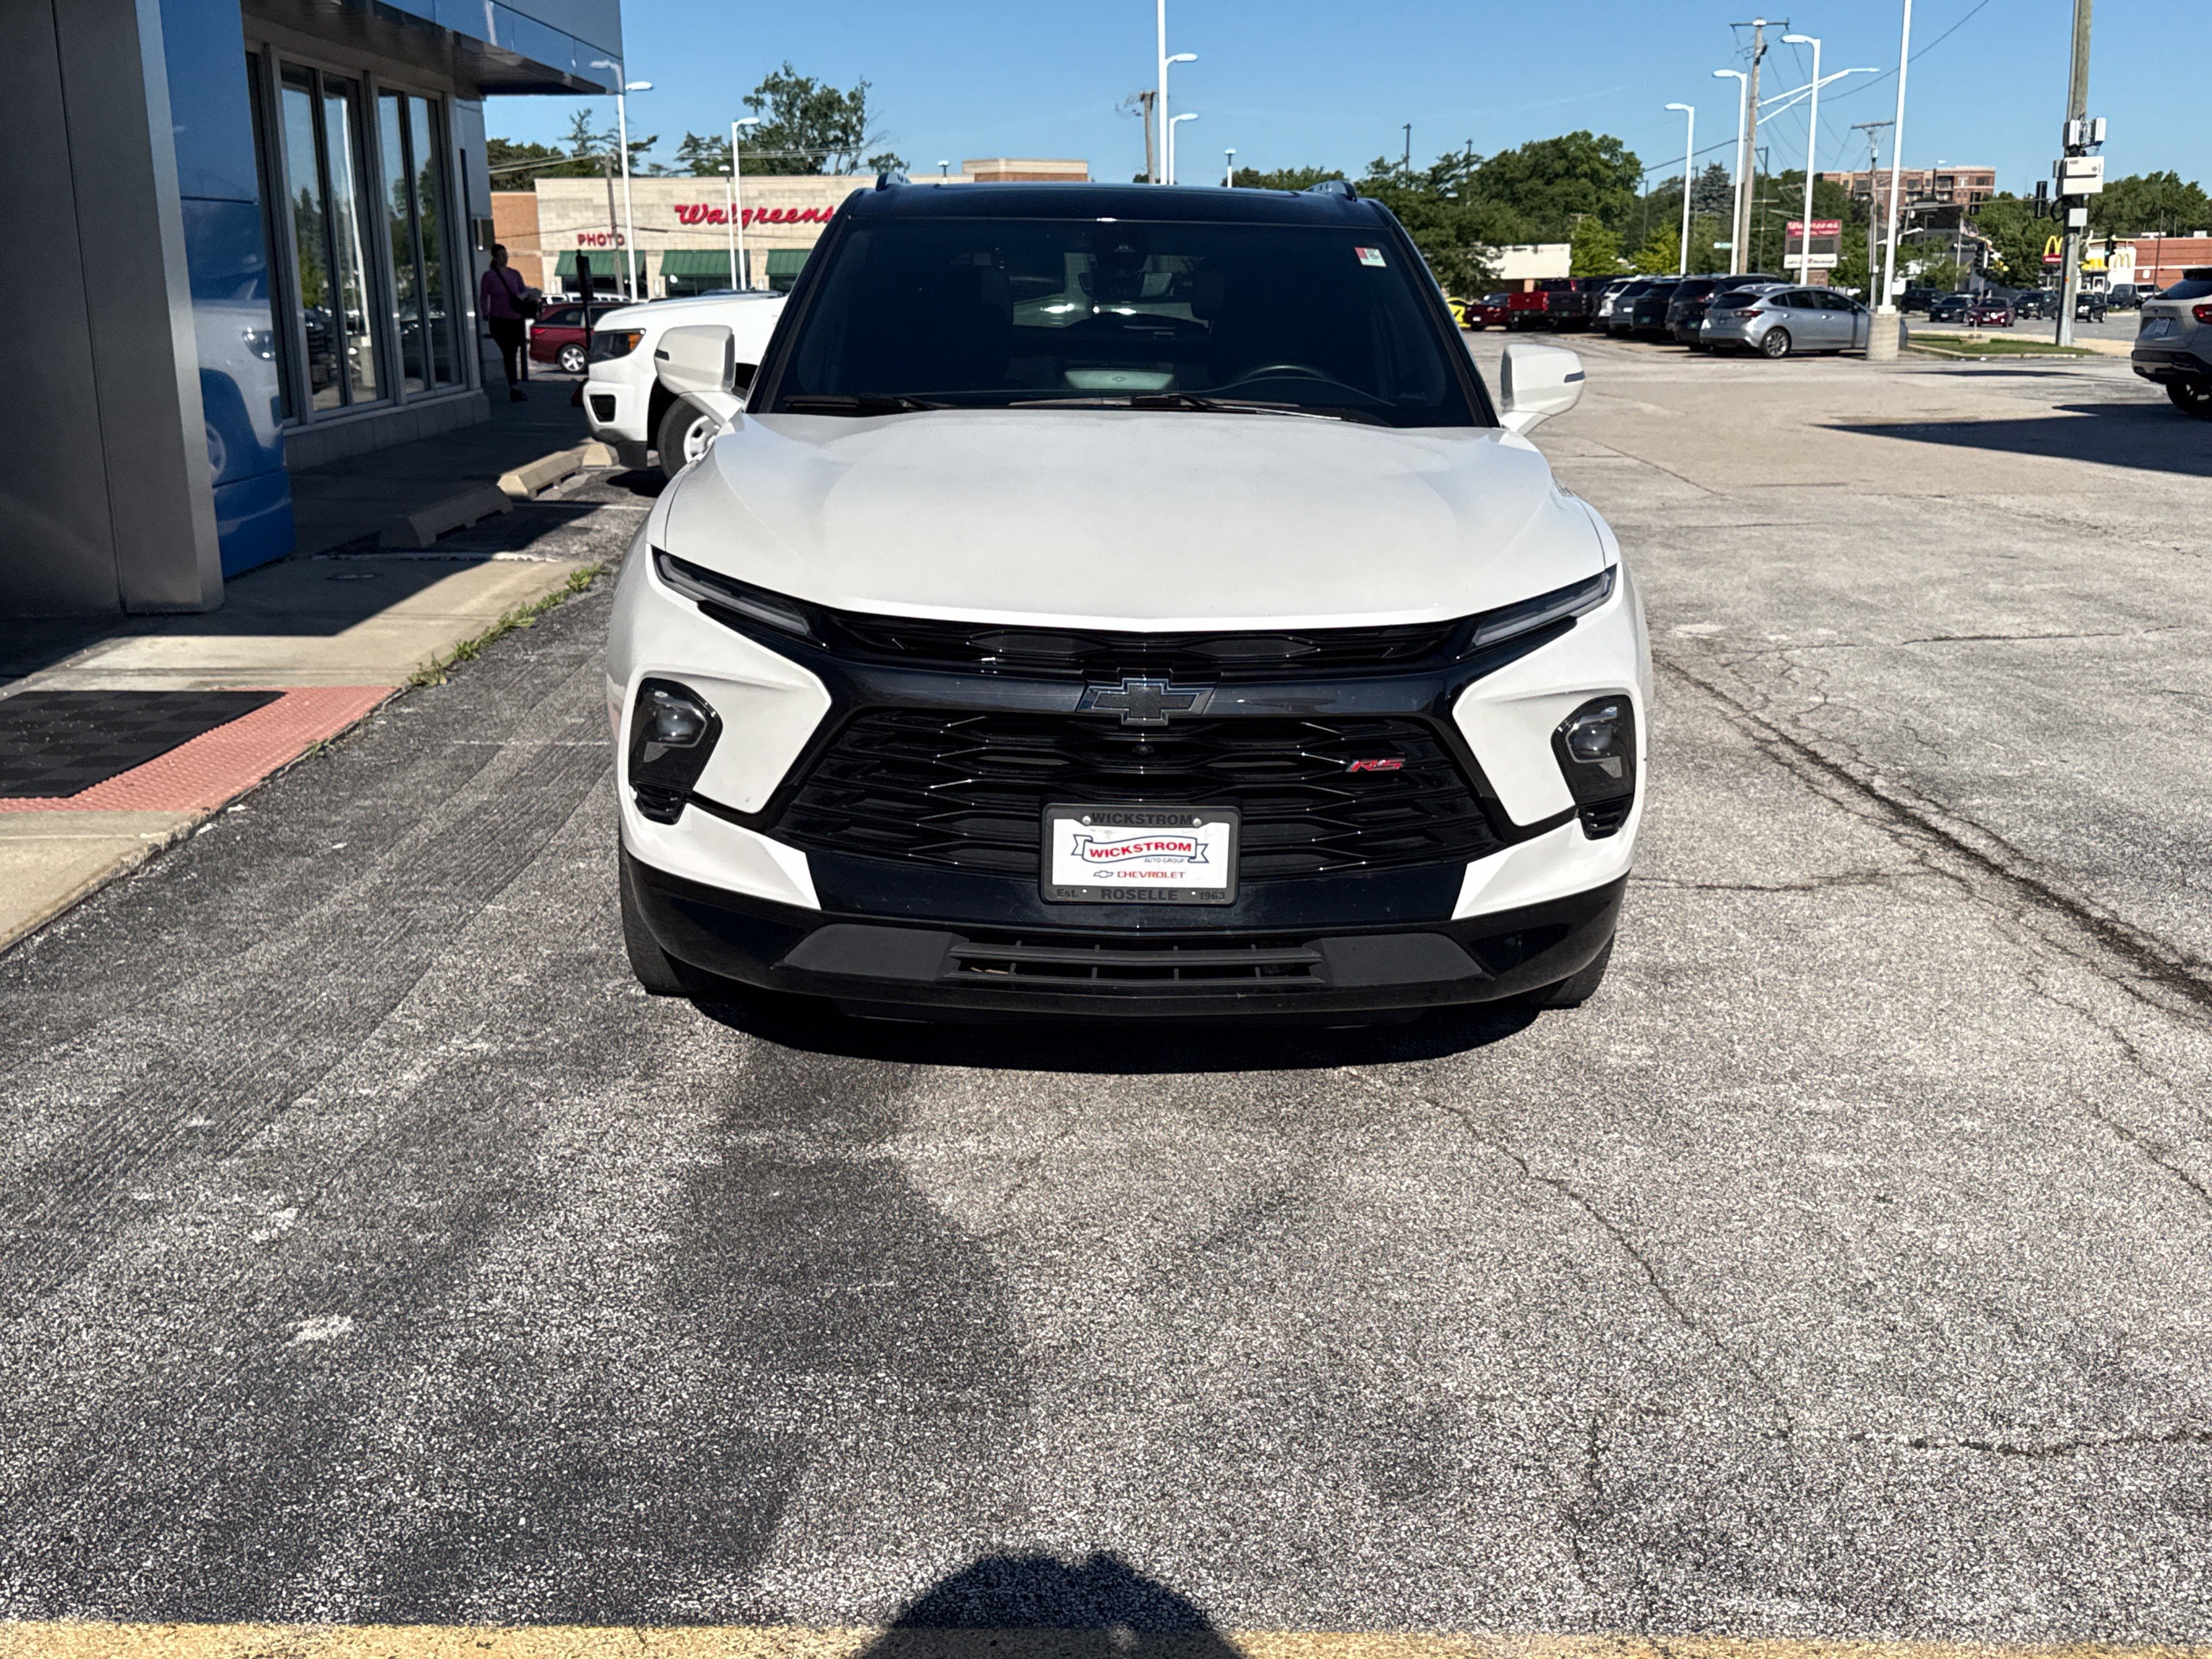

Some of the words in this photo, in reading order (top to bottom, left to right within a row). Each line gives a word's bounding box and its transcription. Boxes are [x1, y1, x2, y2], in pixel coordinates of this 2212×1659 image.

[577, 234, 624, 246] PHOTO
[1346, 758, 1406, 772] RS
[1091, 812, 1193, 826] WICKSTROM
[1090, 842, 1192, 858] WICKSTROM
[1057, 889, 1079, 898] Est.
[1101, 889, 1178, 901] ROSELLE
[1199, 891, 1226, 900] 1963
